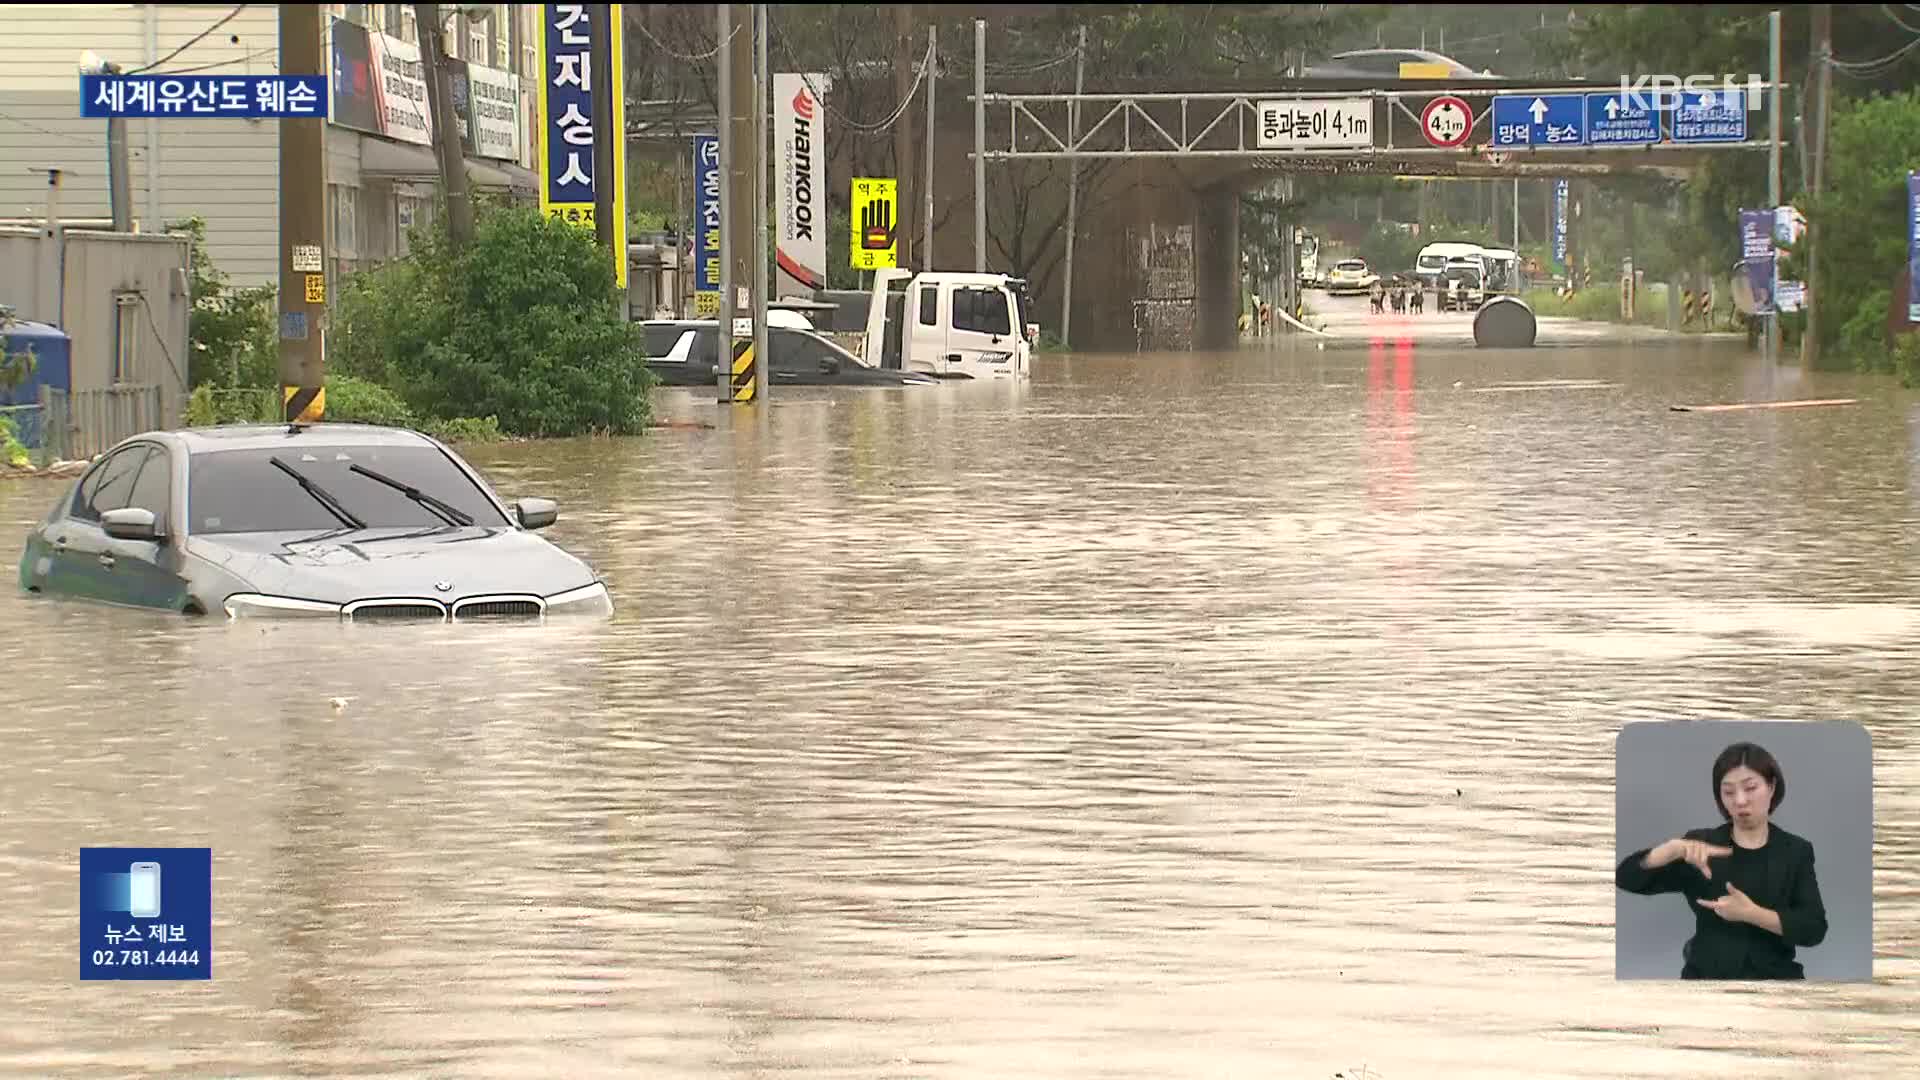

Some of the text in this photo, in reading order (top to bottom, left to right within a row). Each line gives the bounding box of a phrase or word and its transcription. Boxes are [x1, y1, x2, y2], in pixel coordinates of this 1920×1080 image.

[1264, 108, 1367, 139] 통과높이 4.1m
[1431, 116, 1463, 131] 4.1m
[1498, 123, 1578, 143] 망덕 농소
